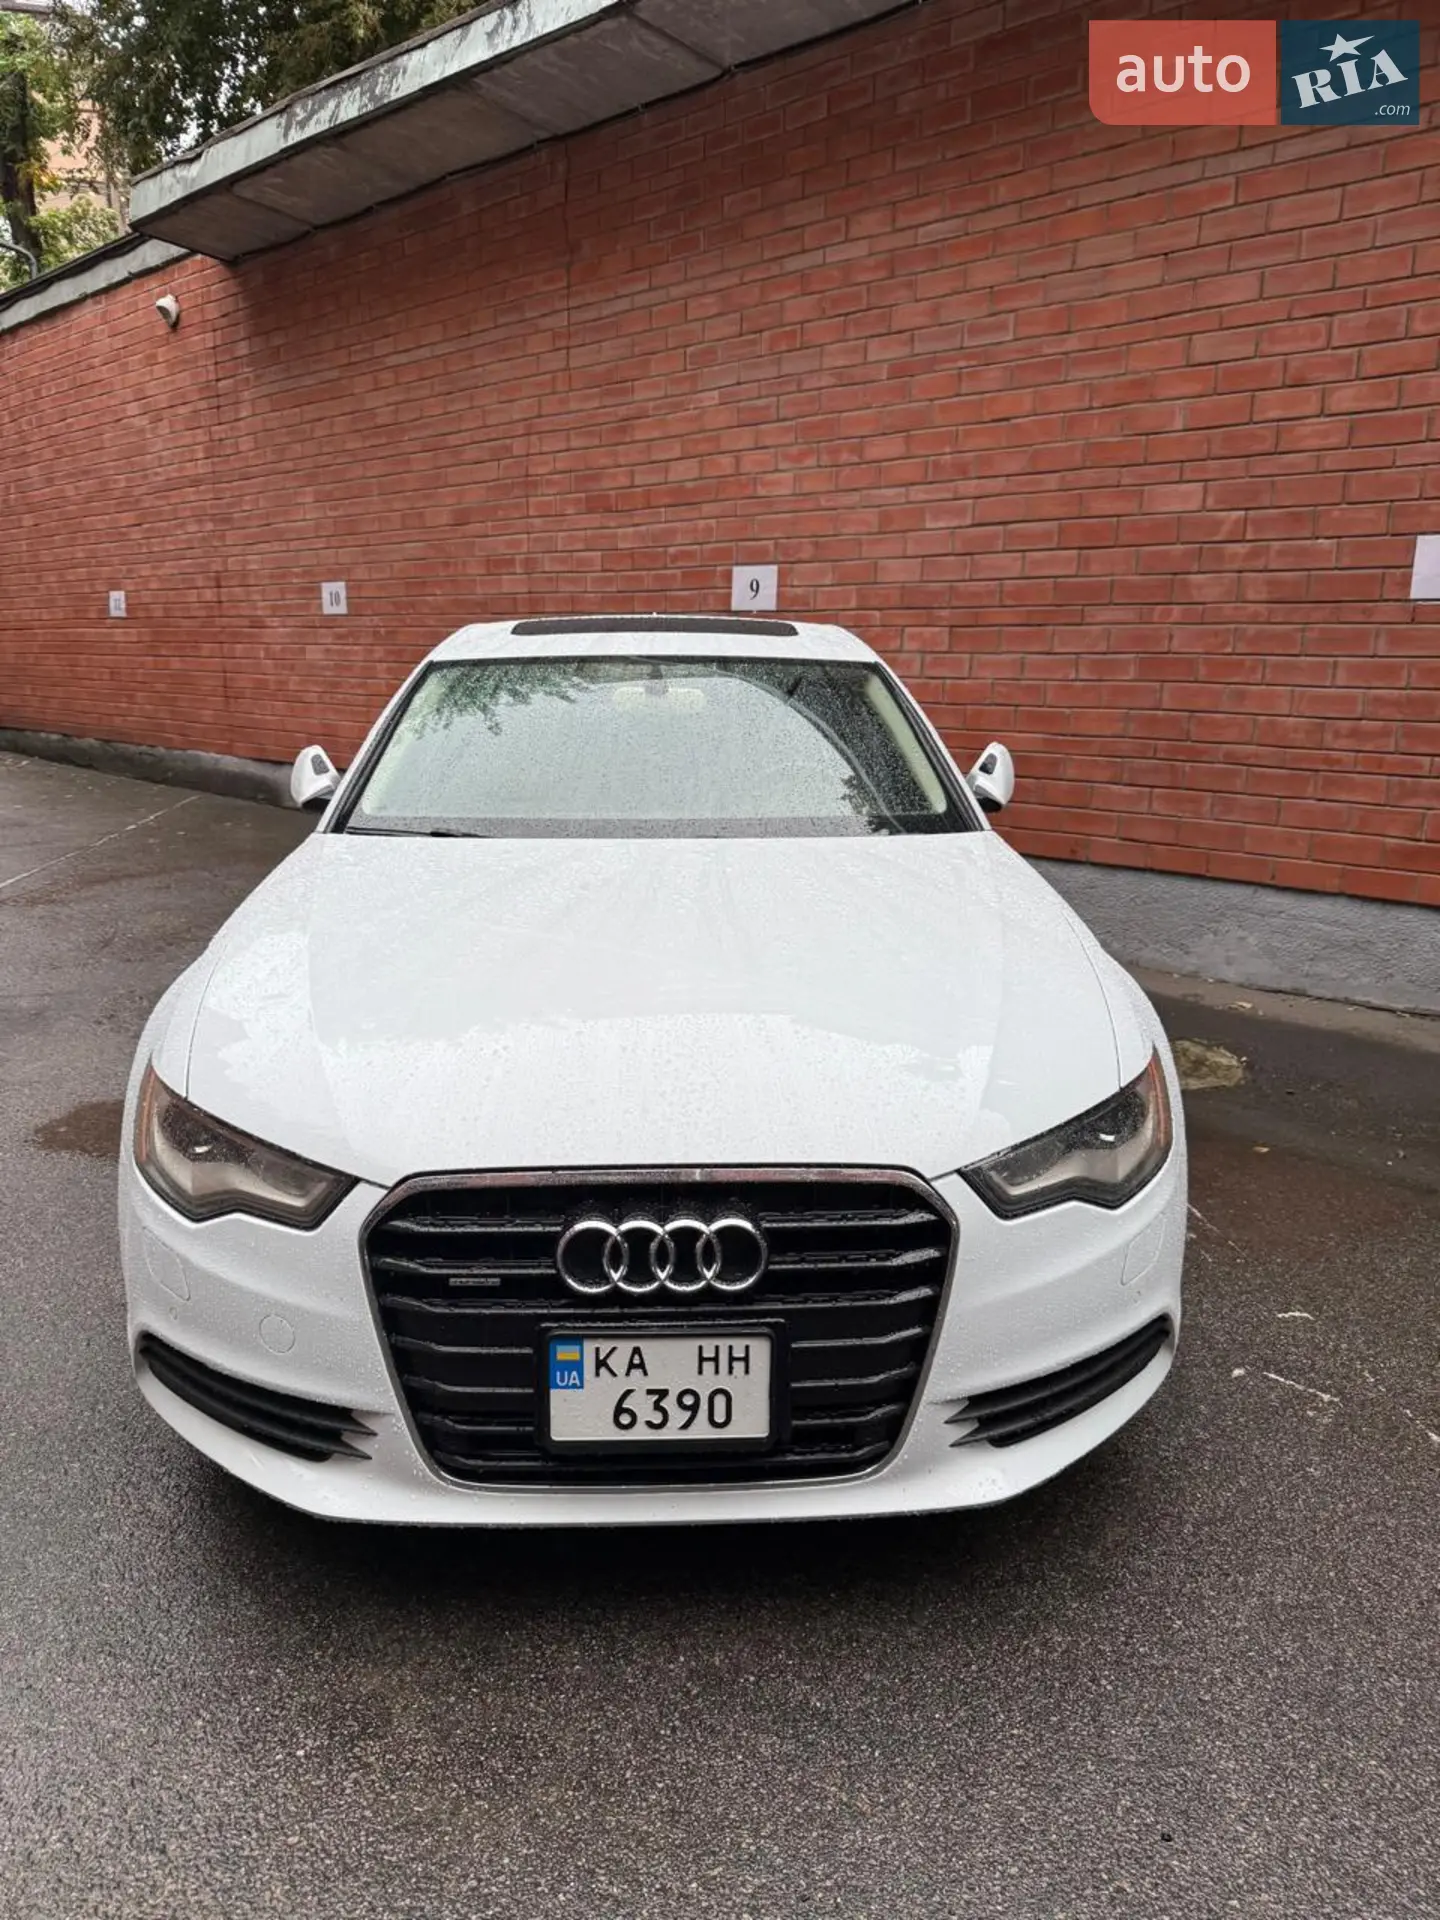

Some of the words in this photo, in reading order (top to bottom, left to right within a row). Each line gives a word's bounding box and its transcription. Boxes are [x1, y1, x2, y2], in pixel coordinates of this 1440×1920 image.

[329, 590, 341, 607] 10
[749, 578, 760, 600] 9
[594, 1346, 649, 1378] KA
[697, 1344, 750, 1376] HH
[556, 1371, 581, 1387] UA
[612, 1387, 733, 1431] 6390
